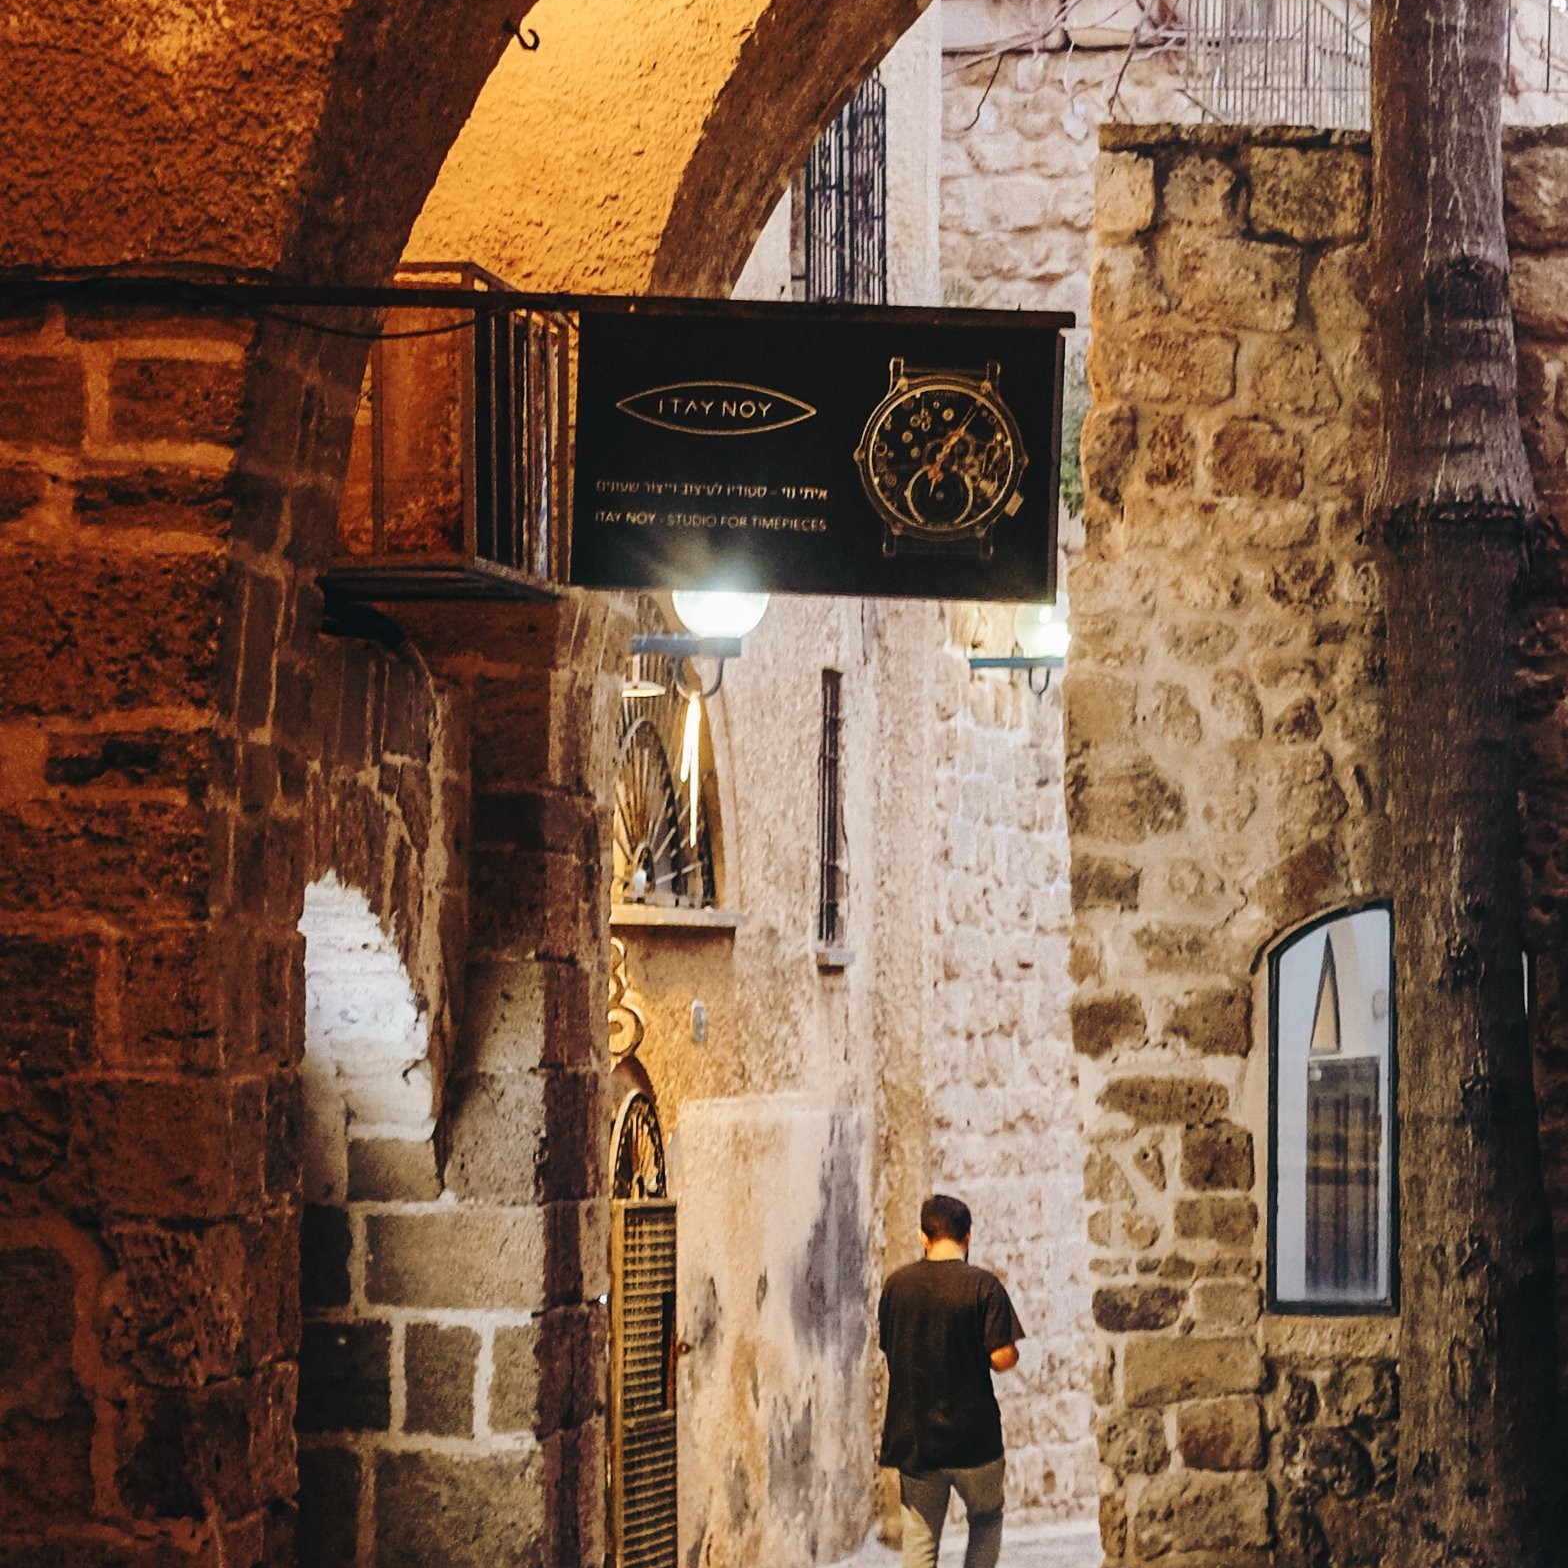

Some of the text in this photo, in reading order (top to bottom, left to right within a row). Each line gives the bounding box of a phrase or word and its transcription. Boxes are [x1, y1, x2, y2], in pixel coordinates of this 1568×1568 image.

[658, 398, 773, 419] ITAY NOY
[595, 479, 640, 495] שעונים
[726, 483, 768, 499] סטודיו
[799, 485, 829, 501] איתי
[595, 511, 622, 523] ITAY
[626, 511, 657, 525] NOY
[666, 513, 717, 529] STUDIO
[720, 514, 748, 528] FOR
[751, 515, 828, 533] TIMEPIECES
